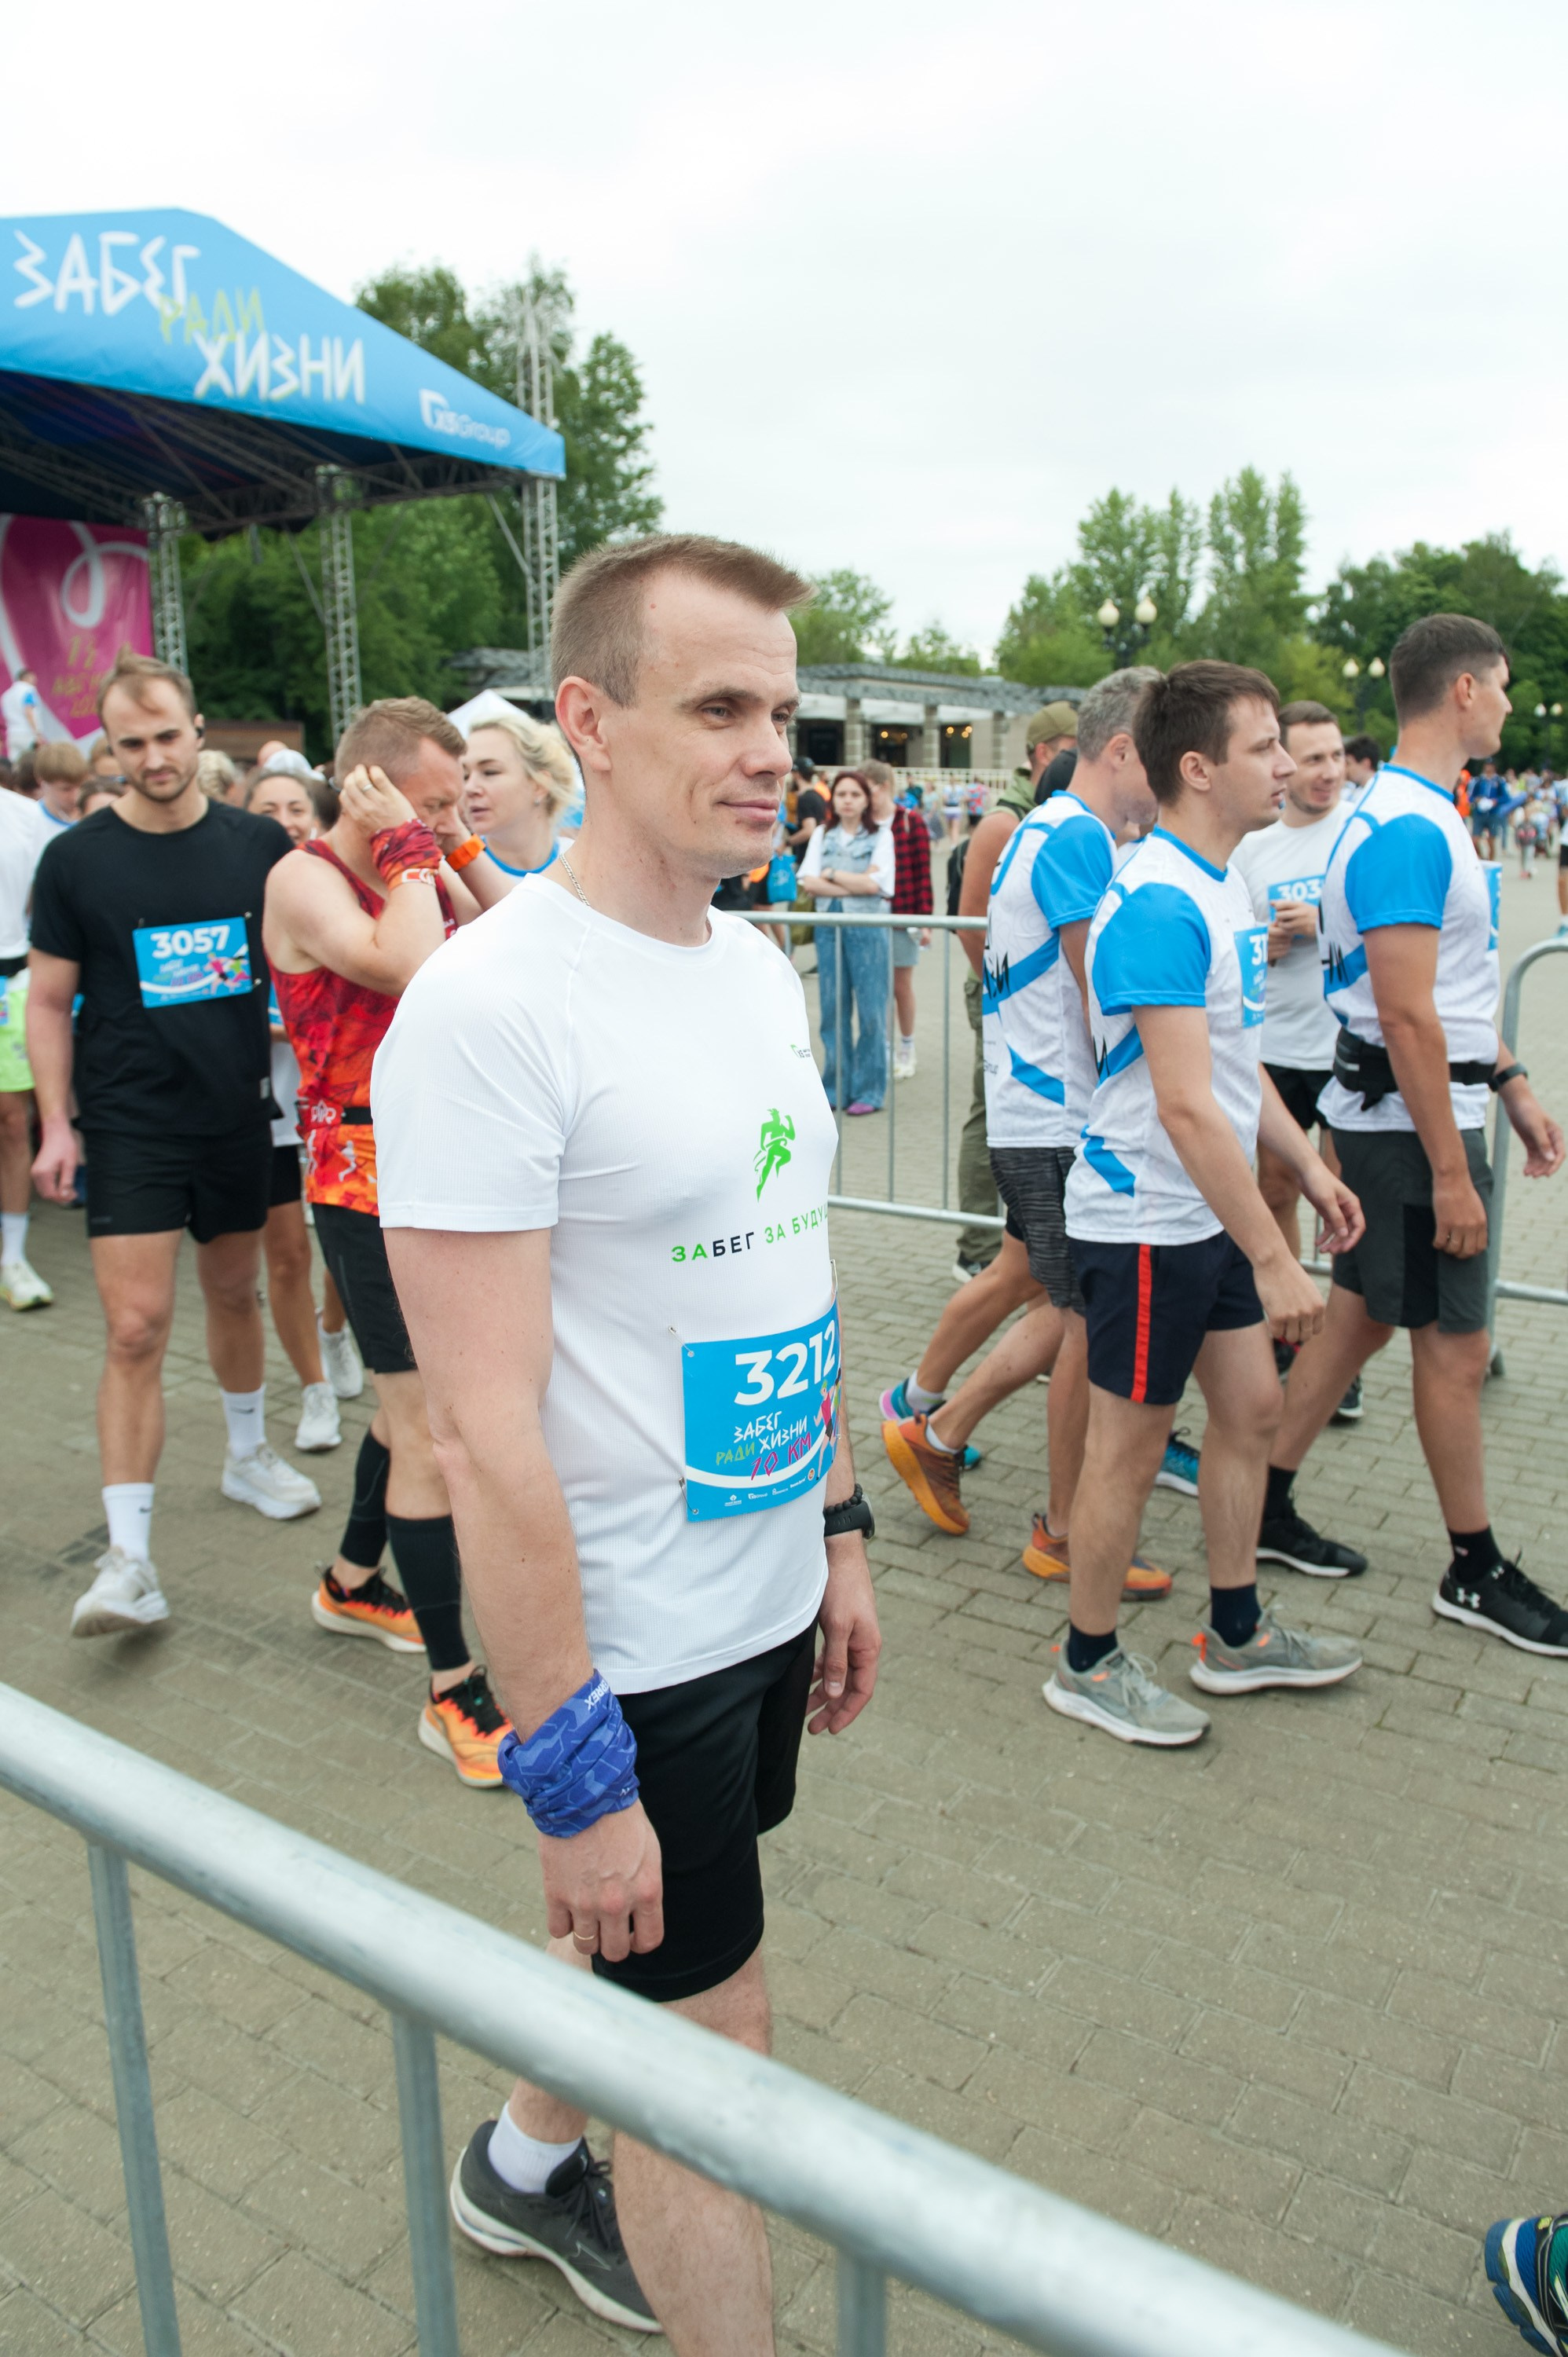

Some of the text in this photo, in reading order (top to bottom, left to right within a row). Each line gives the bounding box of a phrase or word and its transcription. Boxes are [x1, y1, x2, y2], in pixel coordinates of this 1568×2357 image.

[13, 229, 201, 317] ЗАБЕГ
[159, 286, 266, 346] РАДИ
[192, 330, 365, 405] ЖИЗНИ
[150, 924, 231, 959] 3057
[671, 1231, 755, 1263] ЗАБЕГ
[764, 1222, 786, 1244] ЗА
[733, 1319, 836, 1406] 3212
[715, 1415, 808, 1466] РАДИ ЖИЗНИ
[733, 1410, 782, 1444] ЗАБЕГ
[750, 1431, 812, 1481] 10 КМ
